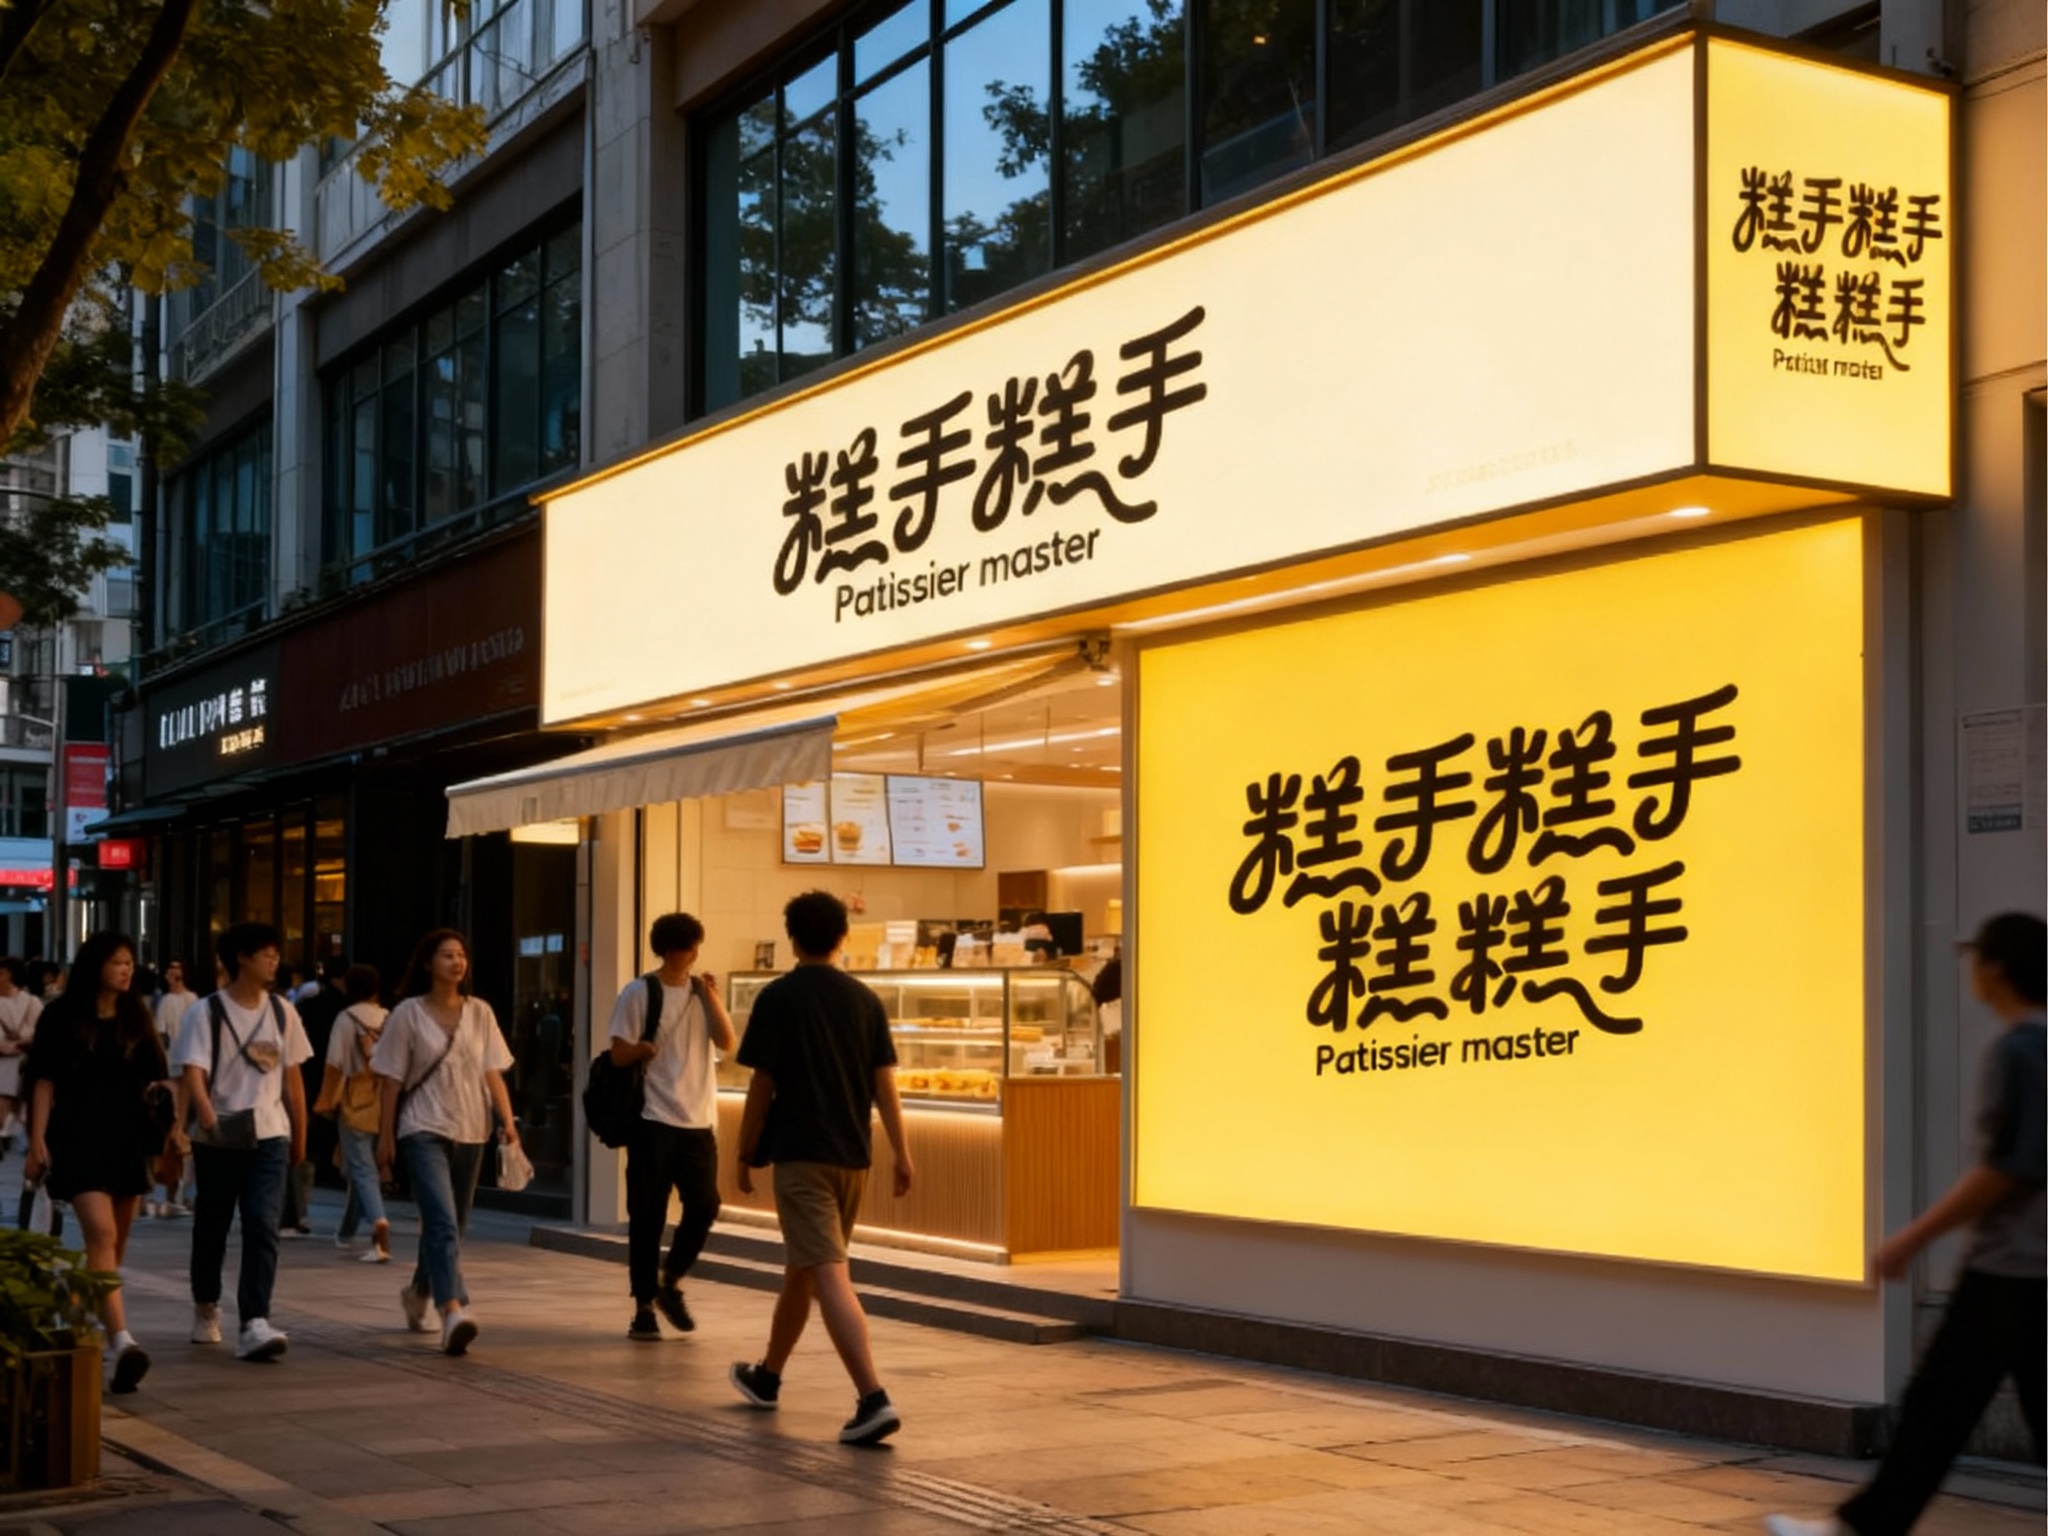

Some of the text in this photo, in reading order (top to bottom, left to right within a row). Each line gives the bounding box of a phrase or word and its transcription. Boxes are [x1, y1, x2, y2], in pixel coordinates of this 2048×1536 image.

[1732, 166, 1943, 268] 糕手糕手
[1770, 261, 1926, 372] 糕糕手
[773, 305, 1208, 597] 糕手糕手
[835, 528, 1100, 623] Patissier master
[1228, 684, 1742, 915] 糕手糕手
[1306, 860, 1689, 1035] 糕糕手
[1316, 1026, 1580, 1076] Patissier master
